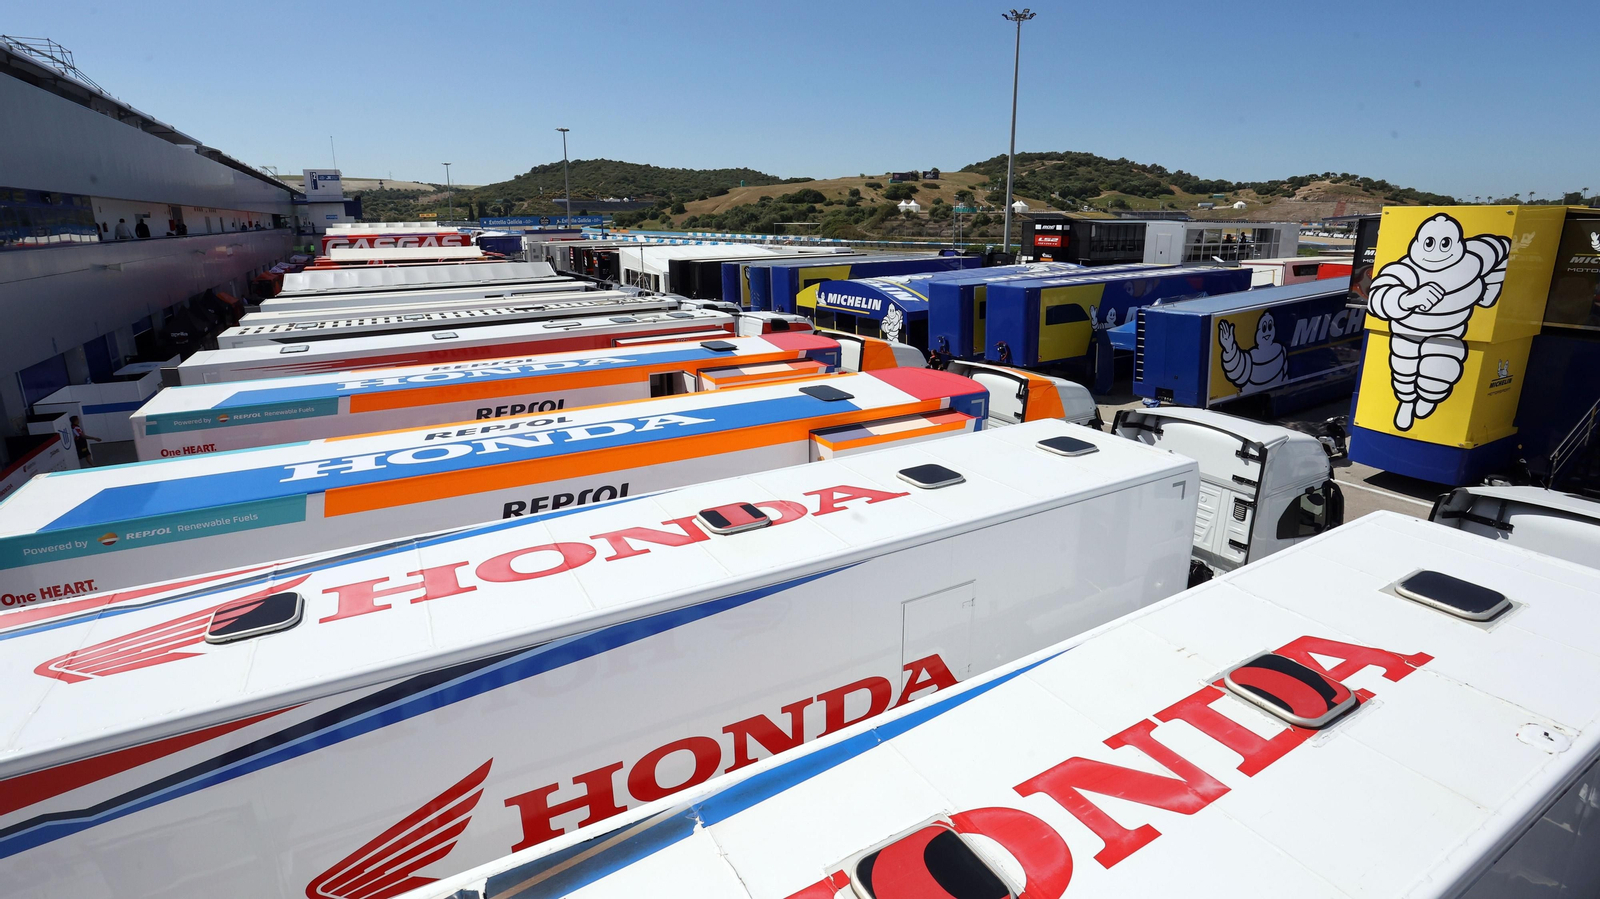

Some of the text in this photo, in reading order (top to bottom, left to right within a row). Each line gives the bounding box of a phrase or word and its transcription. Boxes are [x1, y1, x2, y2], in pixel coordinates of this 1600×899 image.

[827, 293, 882, 311] MICHELIN
[1290, 308, 1366, 347] MICH
[336, 356, 638, 391] HONDA
[432, 358, 538, 371] REPSOL
[173, 418, 203, 426] Powered
[233, 412, 262, 420] REPSOL
[264, 409, 298, 417] Renewable
[424, 416, 573, 441] REPSOL
[160, 443, 217, 458] One HEART.
[279, 413, 716, 483] HONDA
[23, 513, 259, 556] Powered by REPSOL Renewable Fuels
[318, 484, 911, 625] HONDA
[1, 592, 37, 607] One
[39, 579, 98, 600] HEART.
[504, 653, 960, 853] HONDA
[782, 635, 1434, 899] ONDA
